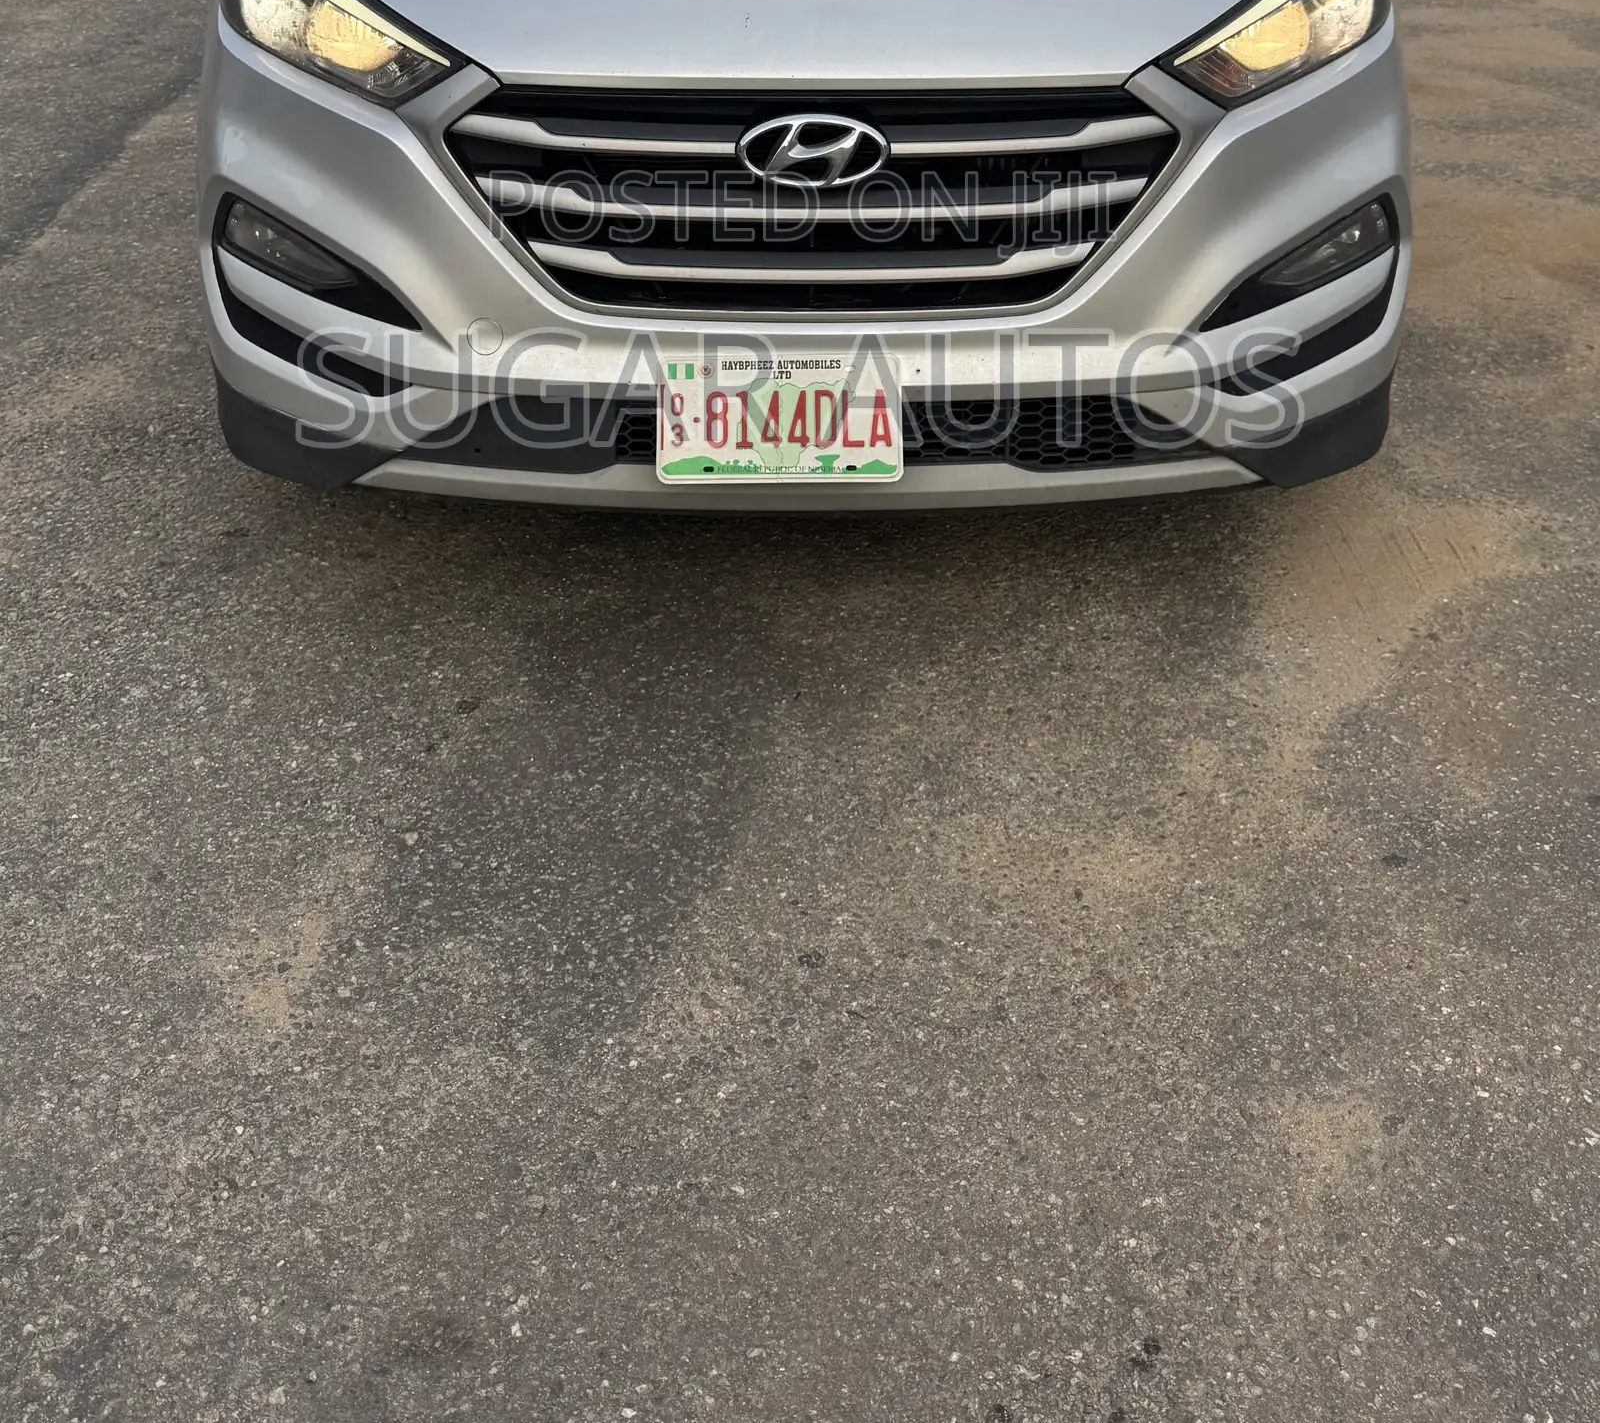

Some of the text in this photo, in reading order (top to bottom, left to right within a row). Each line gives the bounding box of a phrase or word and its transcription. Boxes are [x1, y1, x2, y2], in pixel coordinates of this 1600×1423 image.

[721, 359, 841, 371] HAYBPHEEZ AUTOMOBILES
[773, 371, 792, 380] LTD
